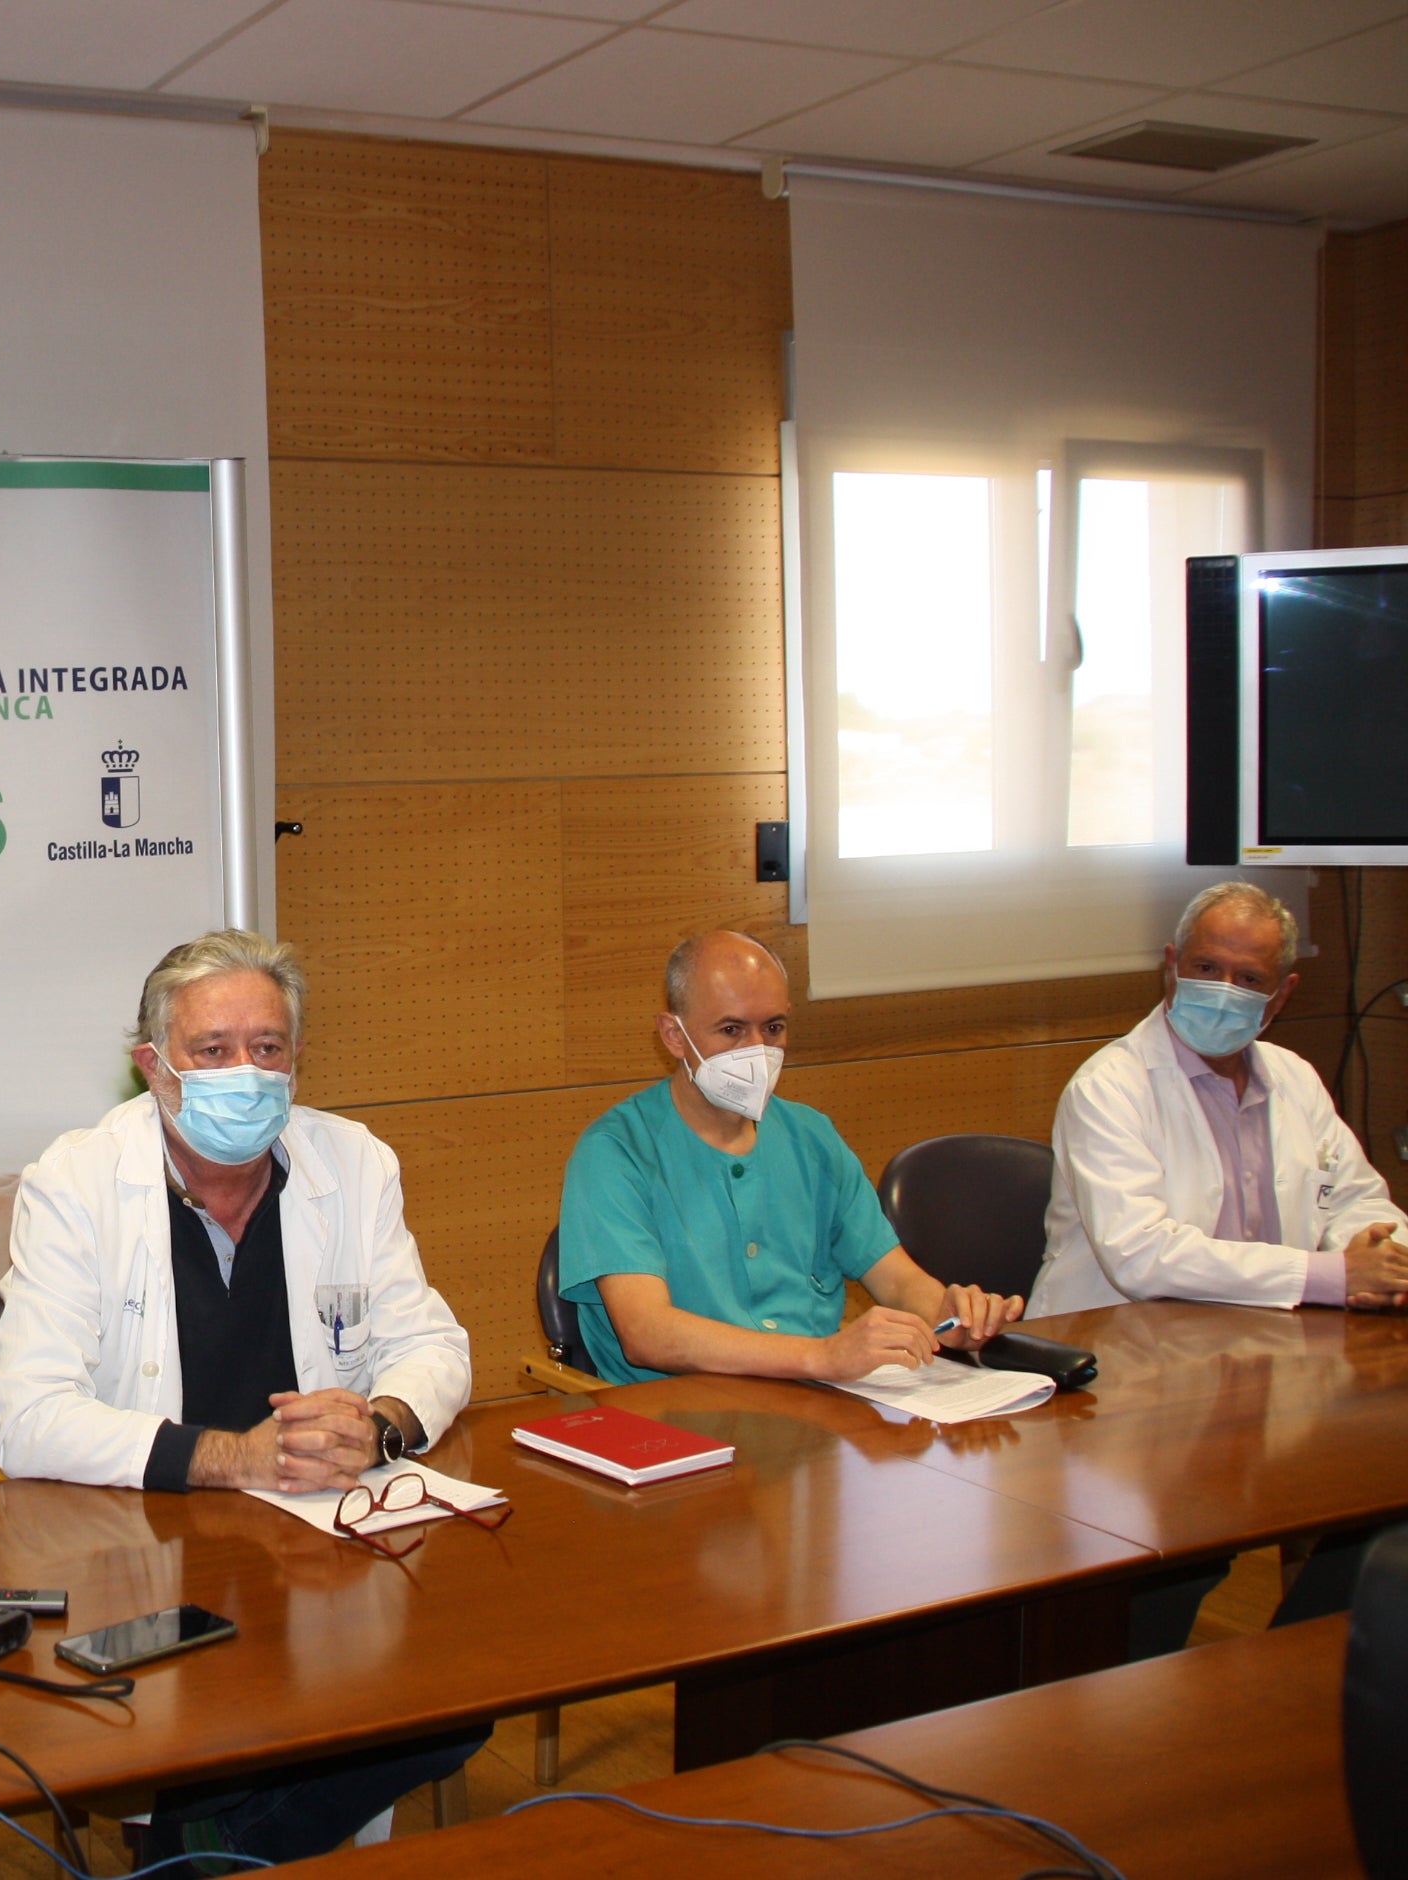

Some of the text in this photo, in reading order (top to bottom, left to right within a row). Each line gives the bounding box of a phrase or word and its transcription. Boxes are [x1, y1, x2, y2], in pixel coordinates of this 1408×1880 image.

[18, 665, 189, 693] INTEGRADA
[47, 836, 194, 861] Castilla-La Mancha
